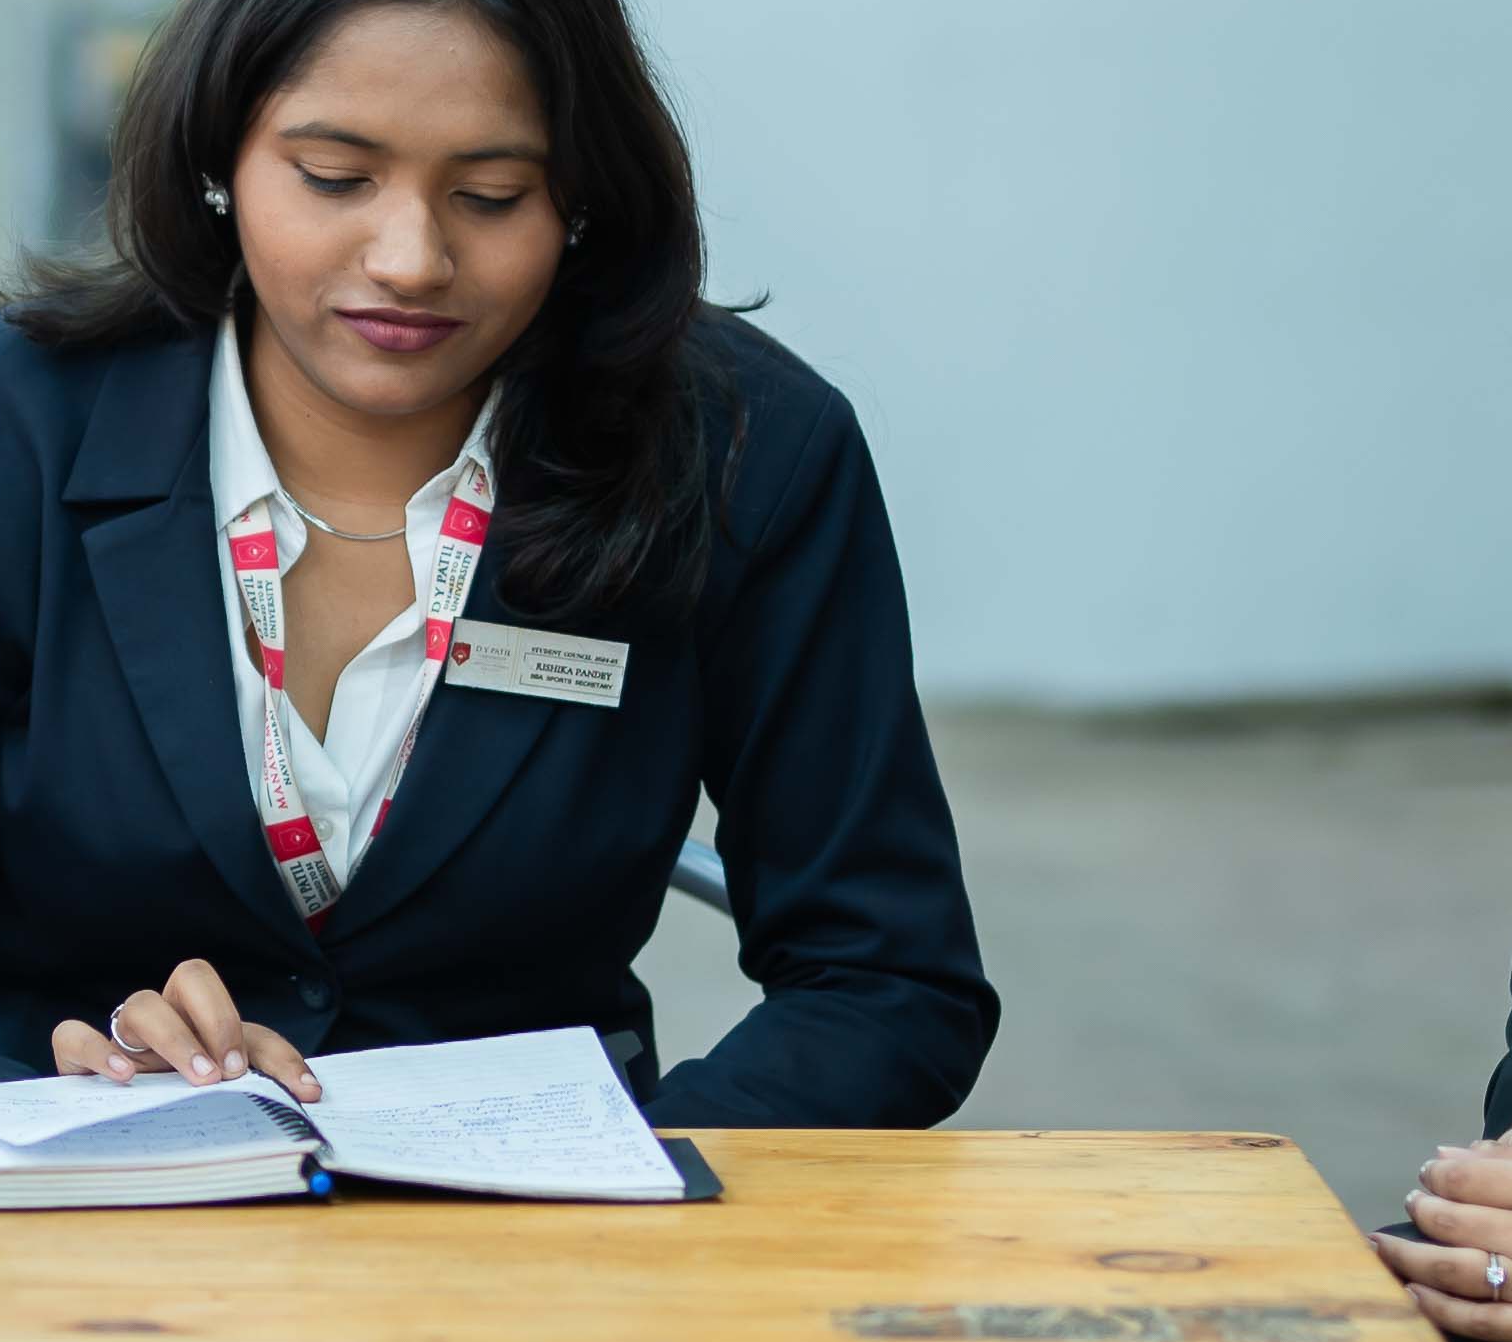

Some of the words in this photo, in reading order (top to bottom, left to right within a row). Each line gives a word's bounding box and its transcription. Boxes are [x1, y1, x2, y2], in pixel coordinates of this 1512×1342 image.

[436, 544, 455, 583] PATIL
[450, 553, 473, 612] UNIVERSITY
[435, 587, 445, 597] Y
[265, 580, 277, 639] UNIVERSITY
[432, 601, 441, 613] D
[531, 646, 561, 657] STUDENT
[536, 662, 573, 675] RISHIKA
[576, 668, 612, 681] PANDEY
[546, 675, 572, 684] SPORTS
[290, 861, 313, 894] PATIL
[303, 894, 316, 904] Y
[308, 902, 321, 914] D
